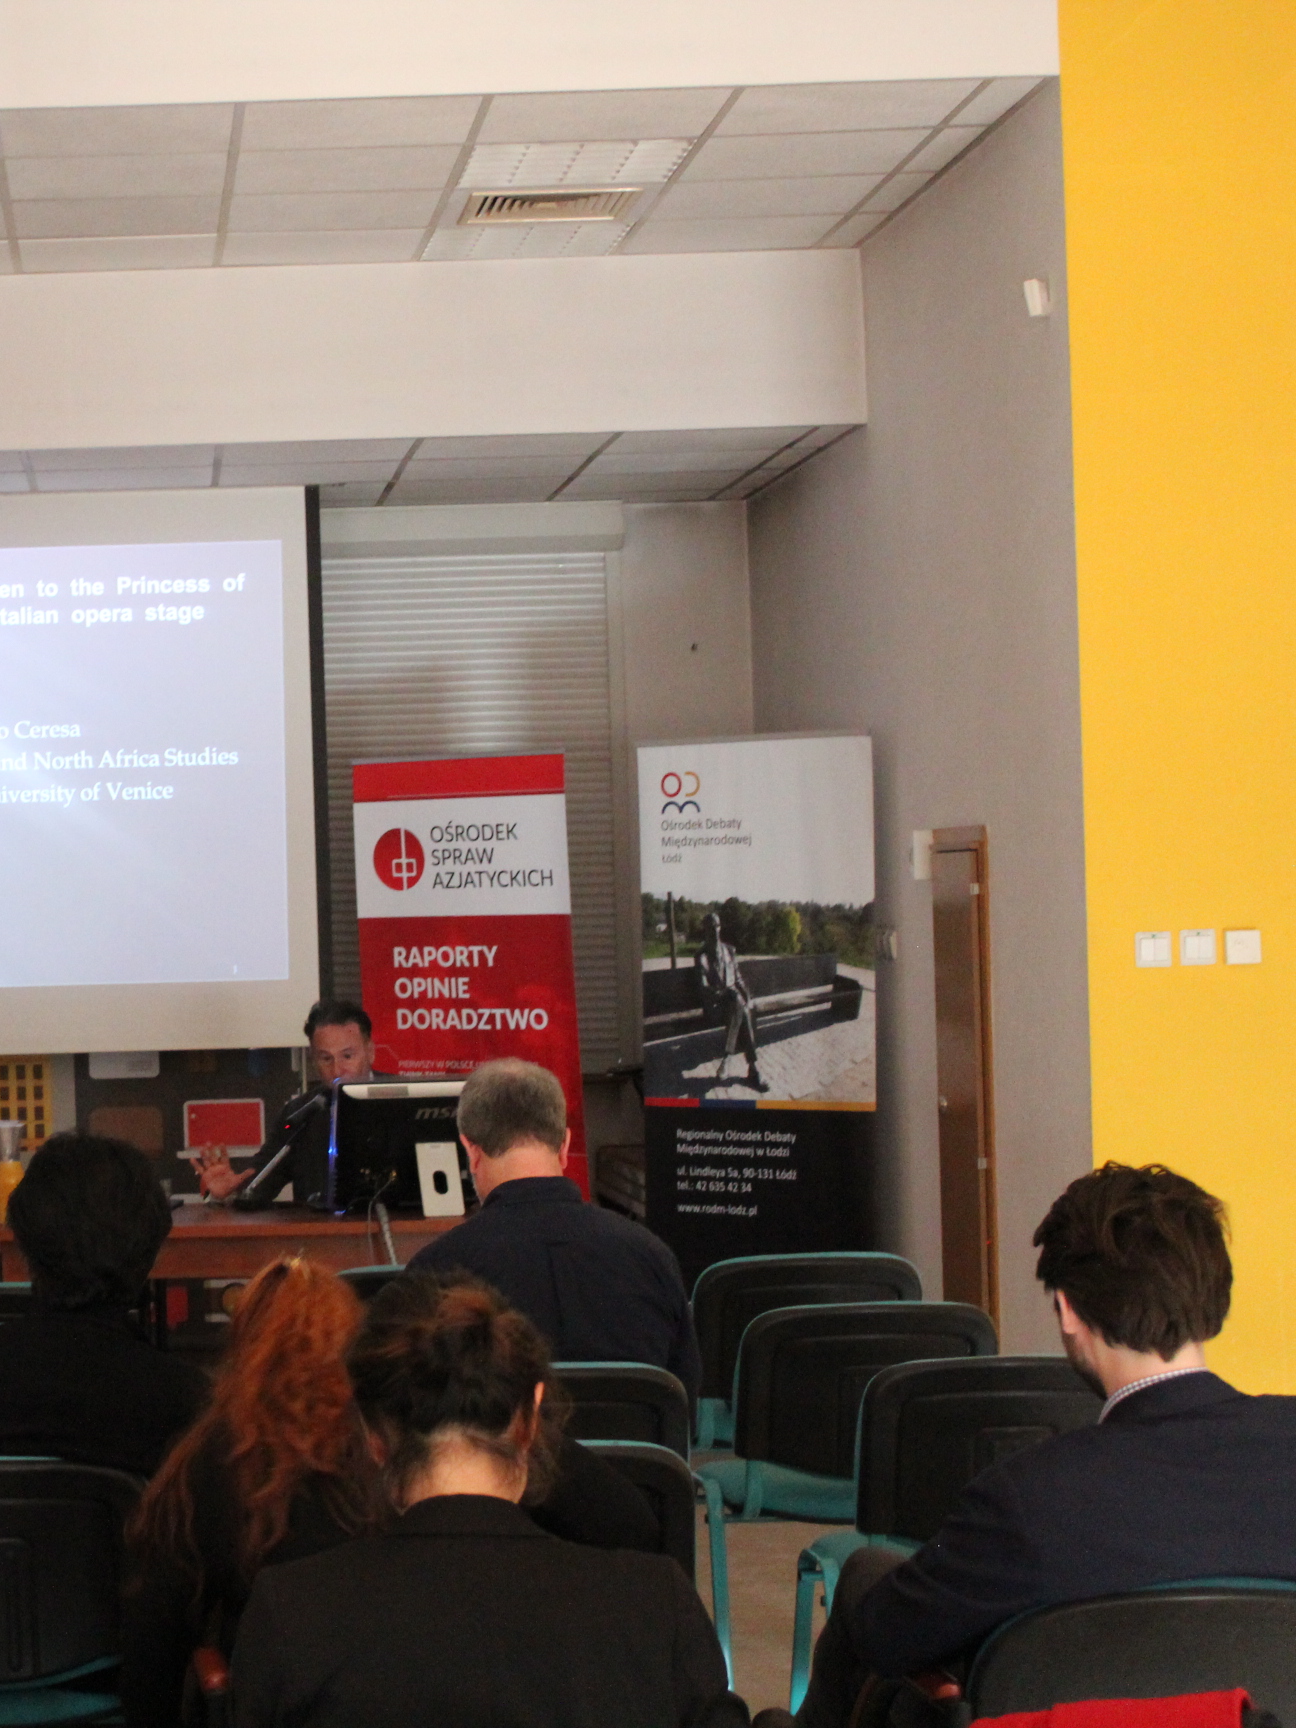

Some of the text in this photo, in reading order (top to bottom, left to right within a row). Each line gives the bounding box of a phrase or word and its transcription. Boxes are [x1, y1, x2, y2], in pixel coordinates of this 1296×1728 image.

[36, 580, 58, 597] to
[70, 578, 104, 596] the
[116, 576, 210, 595] Princess
[222, 573, 246, 591] of
[71, 607, 133, 627] opera
[144, 604, 205, 624] stage
[14, 720, 81, 739] Ceresa
[34, 750, 93, 771] North
[98, 748, 160, 769] Africa
[164, 746, 239, 767] Studies
[80, 781, 101, 801] of
[105, 782, 174, 801] Venice
[430, 821, 518, 843] OŚRODEK
[661, 818, 742, 831] Ośrodek Debaty
[661, 833, 752, 848] Międzynarodowej
[431, 848, 494, 866] SPRAW
[432, 869, 554, 889] AZJATYCKICH
[393, 945, 498, 968] RAPORTY
[394, 977, 470, 999] OPINIE
[396, 1008, 549, 1030] DORADZTWO
[676, 1128, 797, 1144] Regionalny Ośrodek Debaty
[676, 1143, 754, 1158] Międzynarodowej
[766, 1146, 790, 1157] Łodzi
[689, 1166, 726, 1178] Lindleya
[742, 1168, 774, 1179] 90-131
[775, 1169, 797, 1180] Łódź
[695, 1181, 707, 1191] 42
[709, 1182, 726, 1192] 635
[727, 1182, 739, 1192] 42
[741, 1183, 753, 1193] 34
[677, 1203, 758, 1217] www.rodm-lodz.pl
